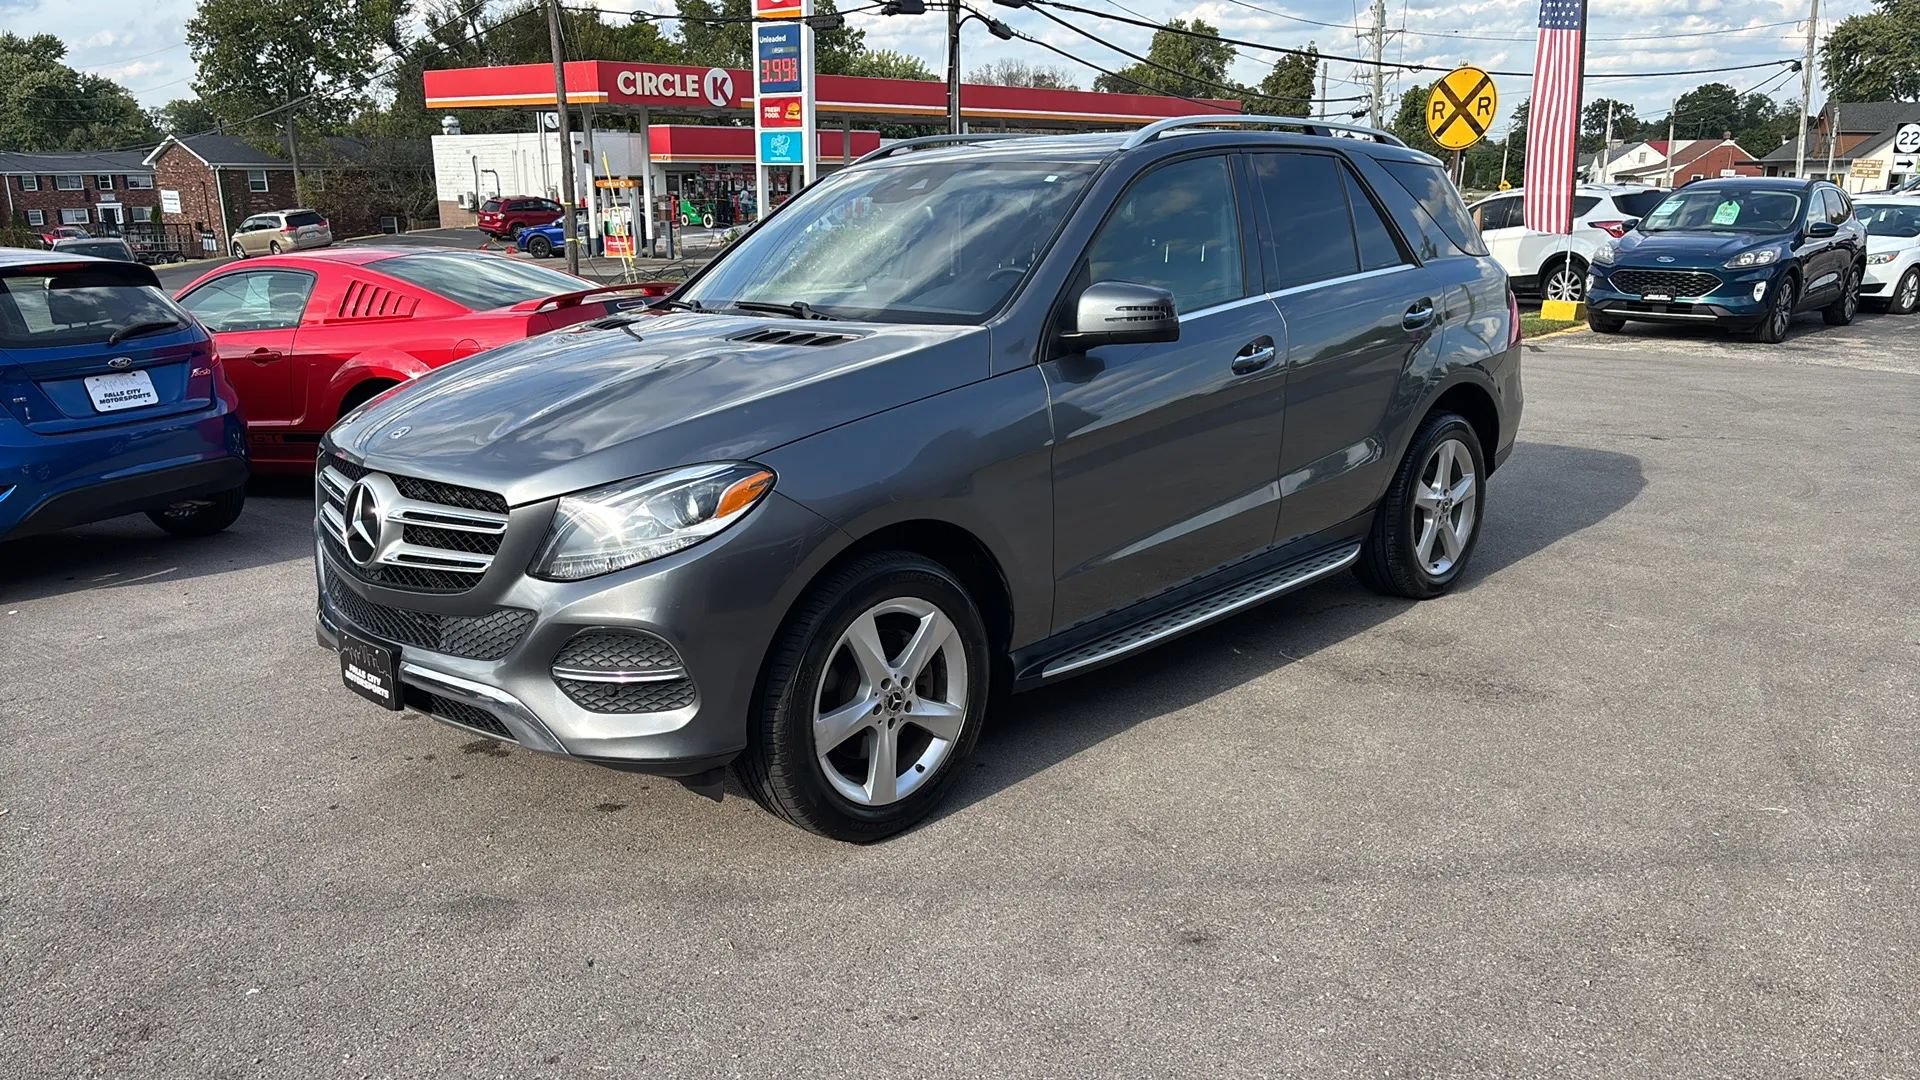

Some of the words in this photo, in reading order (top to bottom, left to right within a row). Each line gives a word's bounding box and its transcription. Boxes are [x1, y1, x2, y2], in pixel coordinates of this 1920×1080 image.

[760, 35, 786, 43] Unleaded
[617, 70, 699, 97] CIRCLE
[709, 73, 732, 105] K
[1432, 101, 1445, 120] R
[1477, 96, 1491, 116] R
[1899, 131, 1920, 145] 22
[99, 392, 151, 404] MOTORSPORTS
[104, 391, 124, 399] FALLS
[126, 388, 141, 396] CITY
[349, 663, 366, 679] FALLS
[367, 673, 381, 686] CITY
[345, 669, 389, 699] MOTORSPORTS
